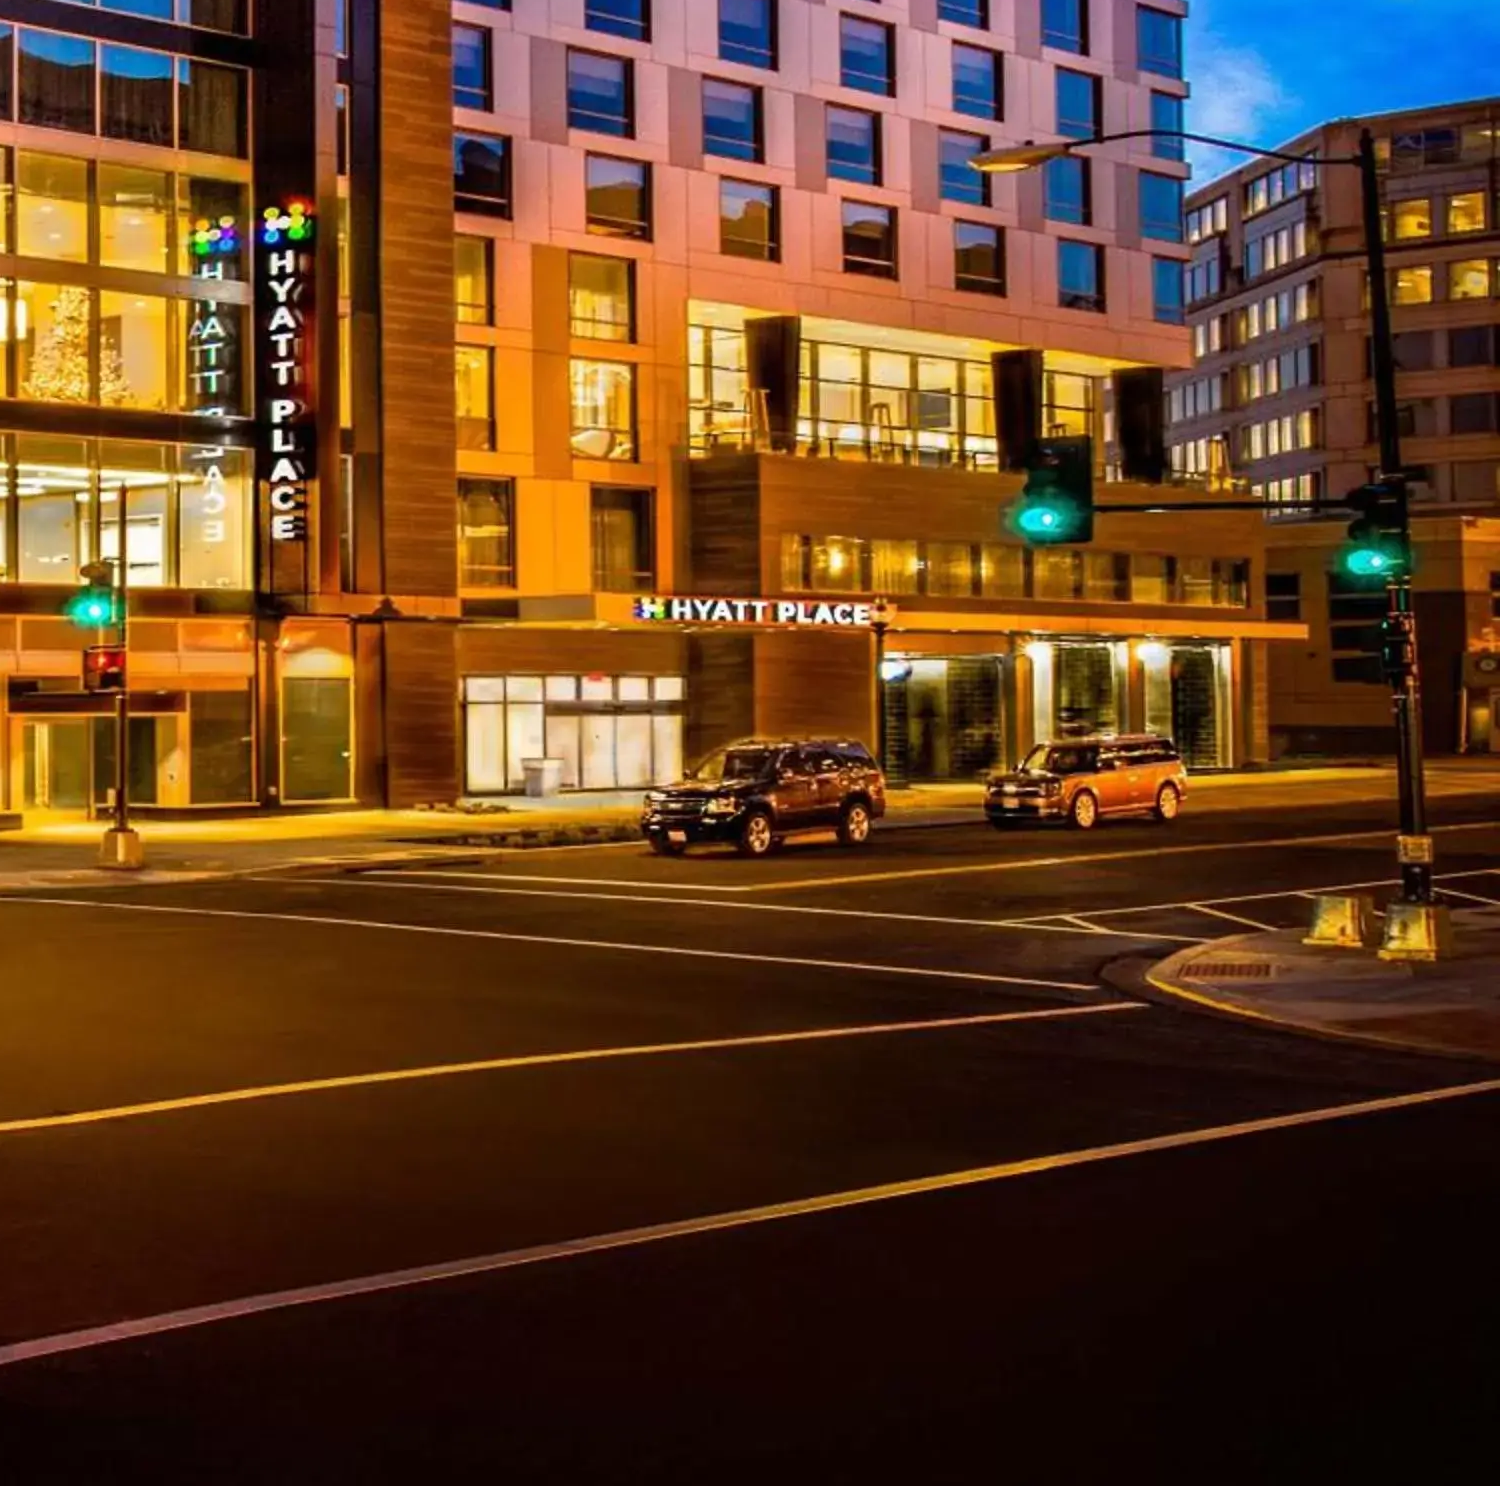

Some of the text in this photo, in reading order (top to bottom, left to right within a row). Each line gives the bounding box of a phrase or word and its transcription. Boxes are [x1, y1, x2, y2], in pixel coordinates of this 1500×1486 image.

[268, 247, 299, 539] HYATT PLACE
[672, 597, 870, 626] HYATT PLACE
